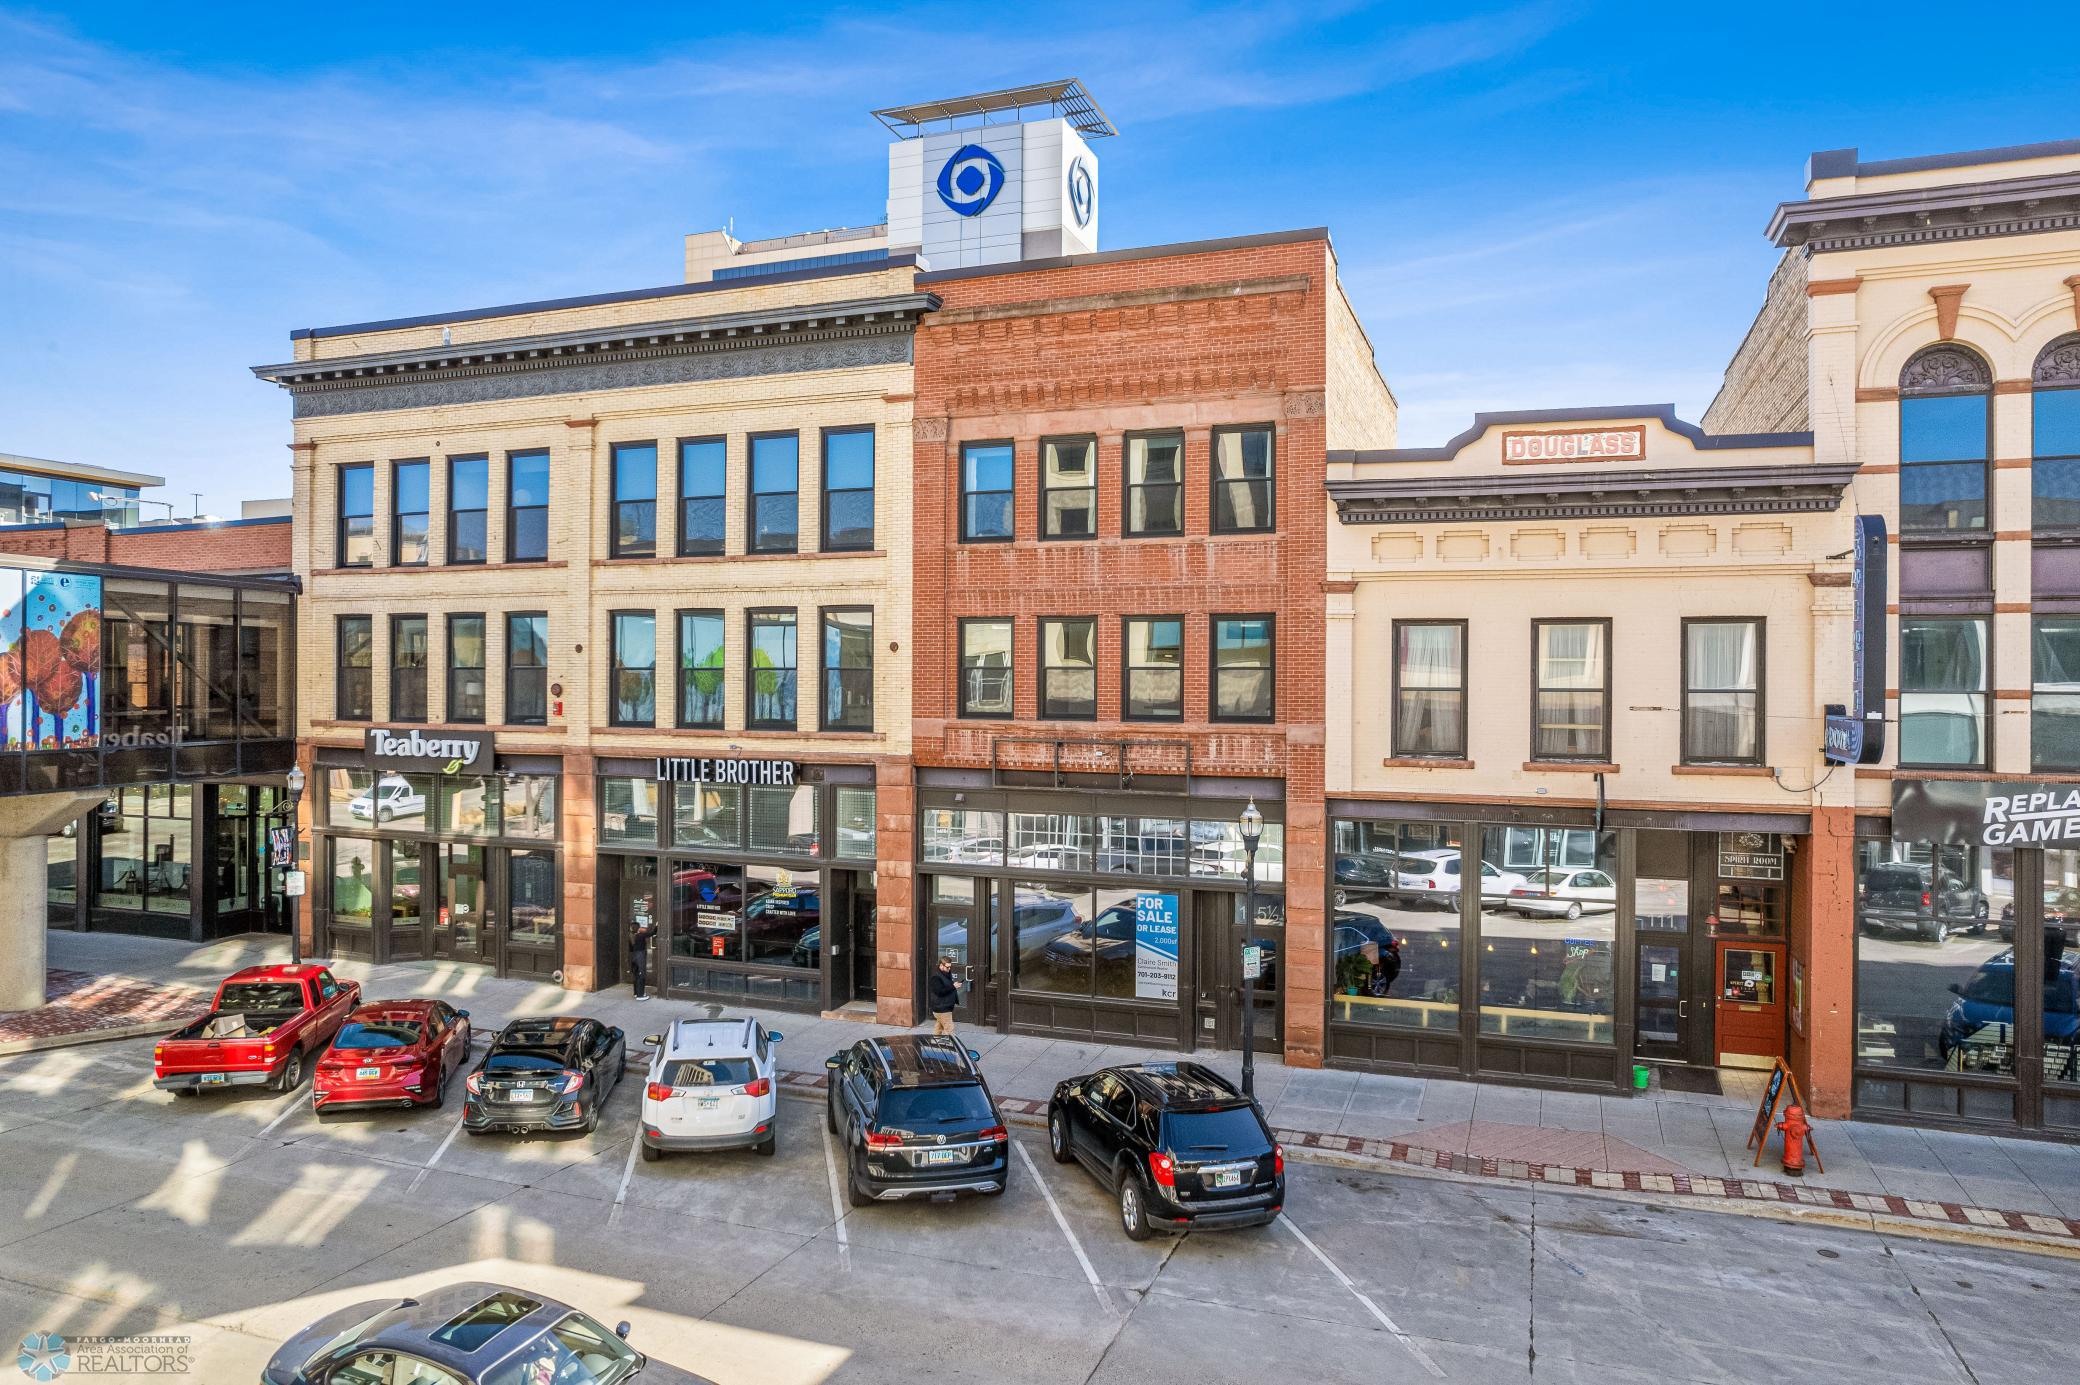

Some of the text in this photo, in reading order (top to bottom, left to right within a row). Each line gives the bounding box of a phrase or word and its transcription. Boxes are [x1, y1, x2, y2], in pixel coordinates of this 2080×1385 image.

[1510, 433, 1637, 458] DOUGLASS
[370, 729, 481, 765] Teaberry
[656, 757, 794, 785] LITTLE BROTHER
[1983, 789, 2080, 824] REPLA
[1983, 817, 2080, 846] GAME
[1724, 855, 1777, 865] SPIRIT ROOM
[633, 864, 652, 877] 117
[1137, 897, 1164, 910] FOR
[1137, 910, 1173, 924] SALE
[1137, 924, 1177, 934] OR LEASE
[1564, 936, 1596, 946] COFFEE
[1567, 946, 1589, 959] Shop
[1138, 957, 1177, 968] Claire Smith
[1162, 989, 1177, 998] kcr
